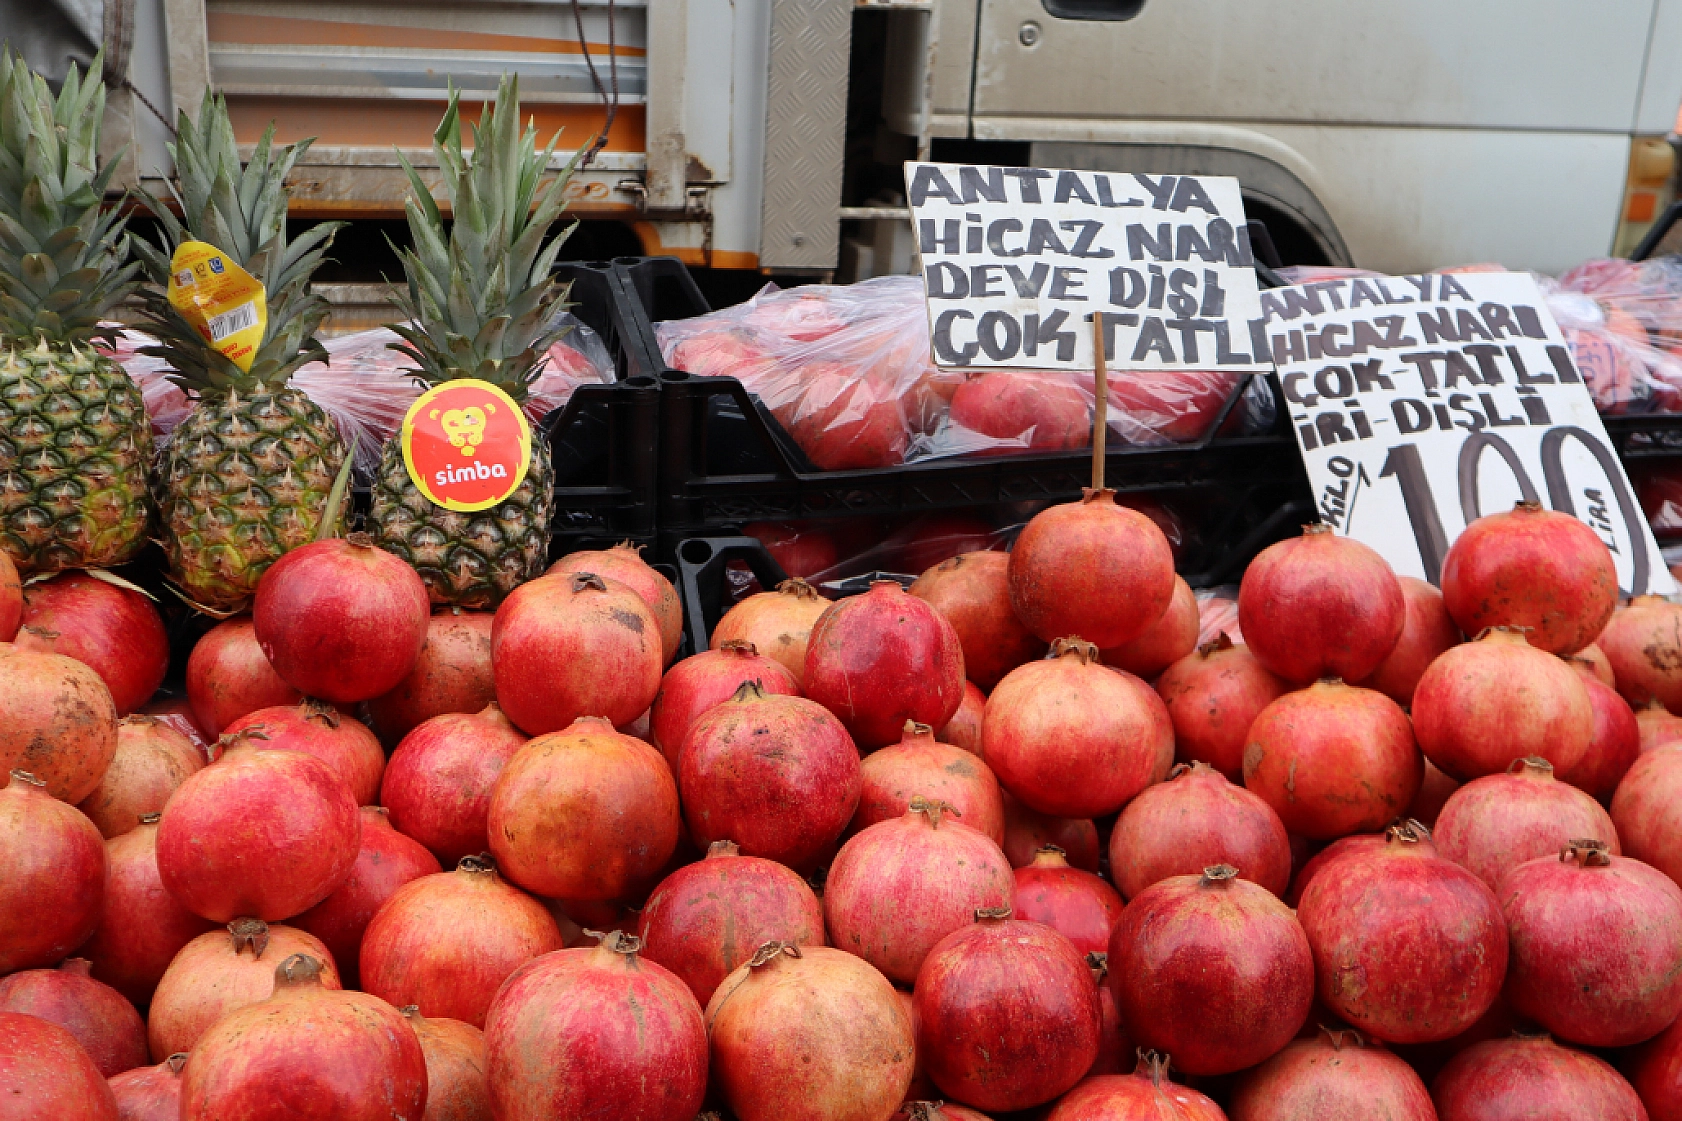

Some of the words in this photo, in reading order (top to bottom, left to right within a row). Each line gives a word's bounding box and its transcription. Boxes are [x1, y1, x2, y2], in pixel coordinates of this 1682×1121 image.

[910, 165, 1220, 216] ANTALYA
[1125, 216, 1254, 267] NARI
[926, 261, 1088, 301] DEVE
[1261, 274, 1474, 324] ANTALYA
[1084, 311, 1273, 364] TATLI
[1416, 302, 1548, 344] NARI
[435, 461, 507, 486] simba
[1379, 425, 1651, 598] 100
